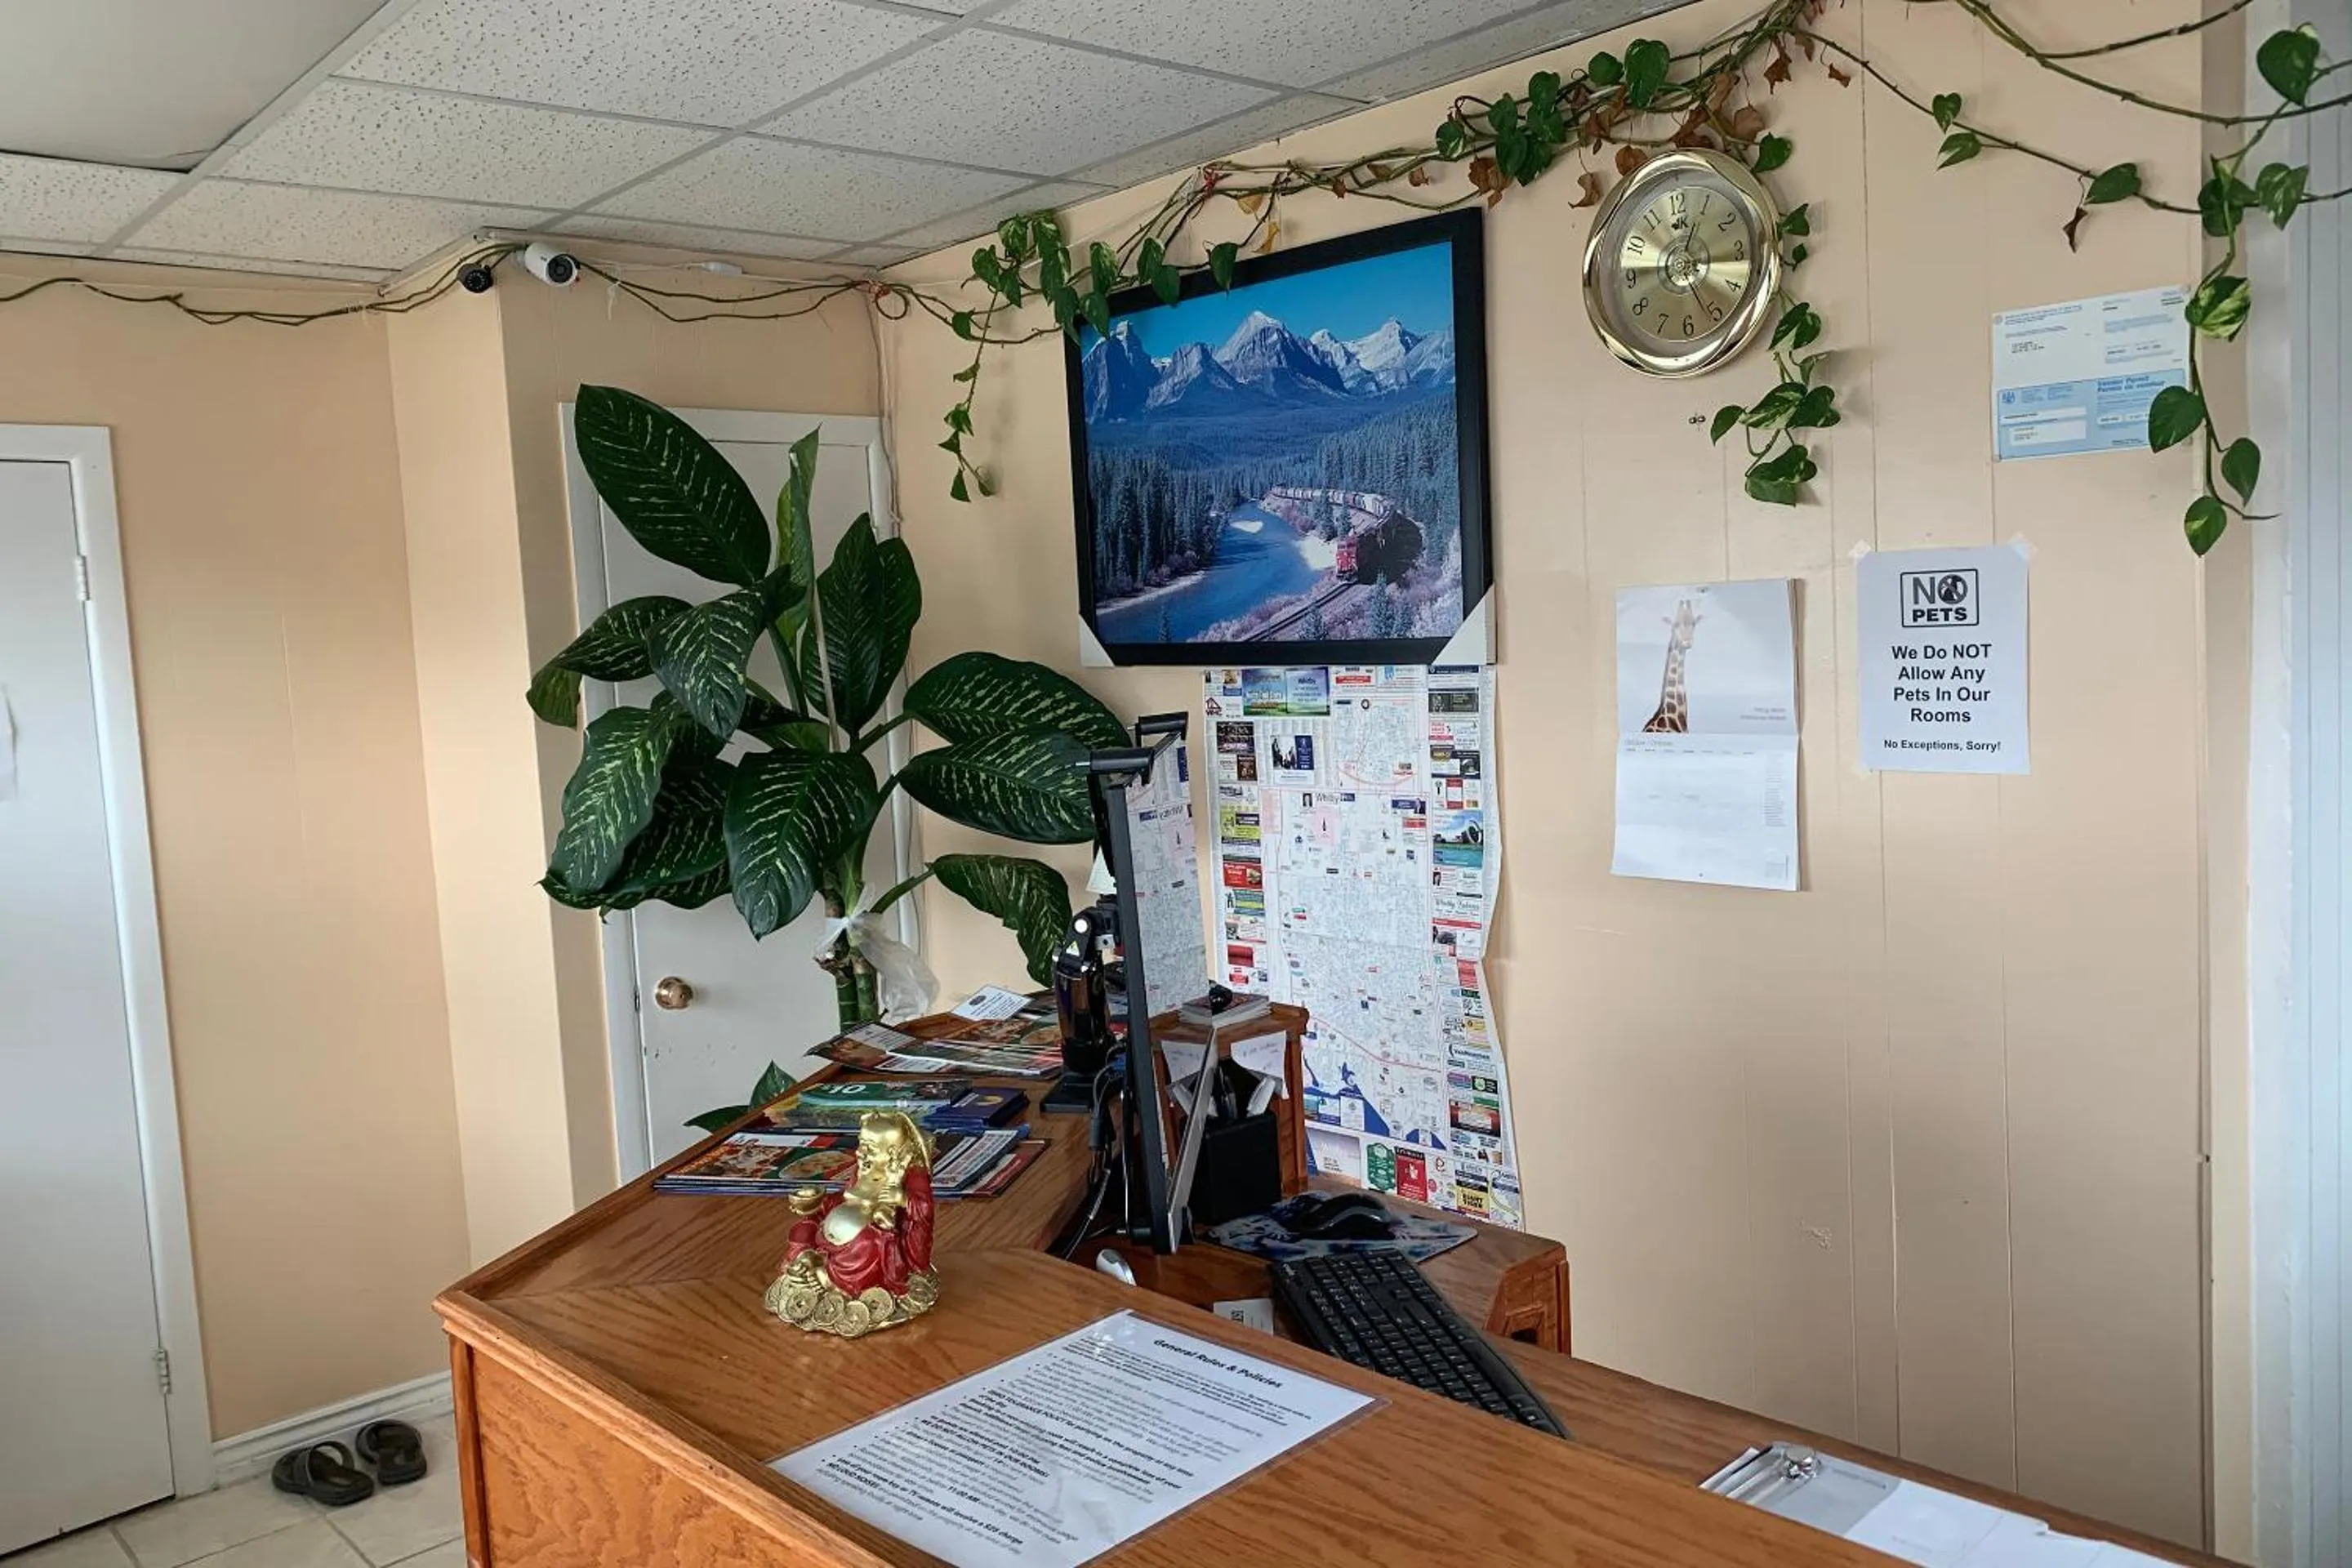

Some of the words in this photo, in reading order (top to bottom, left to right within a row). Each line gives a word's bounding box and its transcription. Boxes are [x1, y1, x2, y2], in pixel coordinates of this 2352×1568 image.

[1668, 193, 1686, 216] 12
[1699, 194, 1710, 216] 1
[1643, 209, 1663, 230] 11
[1718, 213, 1736, 232] 2
[1627, 235, 1646, 256] 10
[1734, 240, 1744, 262] 3
[1624, 270, 1637, 289] 9
[1725, 278, 1742, 292] 4
[1632, 297, 1649, 316] 8
[1707, 301, 1723, 322] 5
[1656, 314, 1669, 335] 7
[1682, 315, 1695, 337] 6
[1913, 574, 1967, 605] NO
[1913, 607, 1967, 623] PETS
[1892, 645, 1918, 659] We
[1923, 645, 1947, 659] Do
[1953, 644, 1992, 658] NOT
[1898, 666, 1945, 680] Allow
[1951, 666, 1986, 683] Any
[1894, 687, 1931, 702] Pets
[1936, 687, 1952, 702] In
[1957, 687, 1991, 702] Our
[1911, 708, 1971, 722] Rooms
[1884, 739, 1898, 749] No
[1901, 740, 1962, 752] Exceptions,
[1966, 741, 2001, 753] Sorry!
[1154, 1340, 1196, 1356] General
[1196, 1355, 1226, 1367] Rules
[1237, 1369, 1281, 1388] Policies
